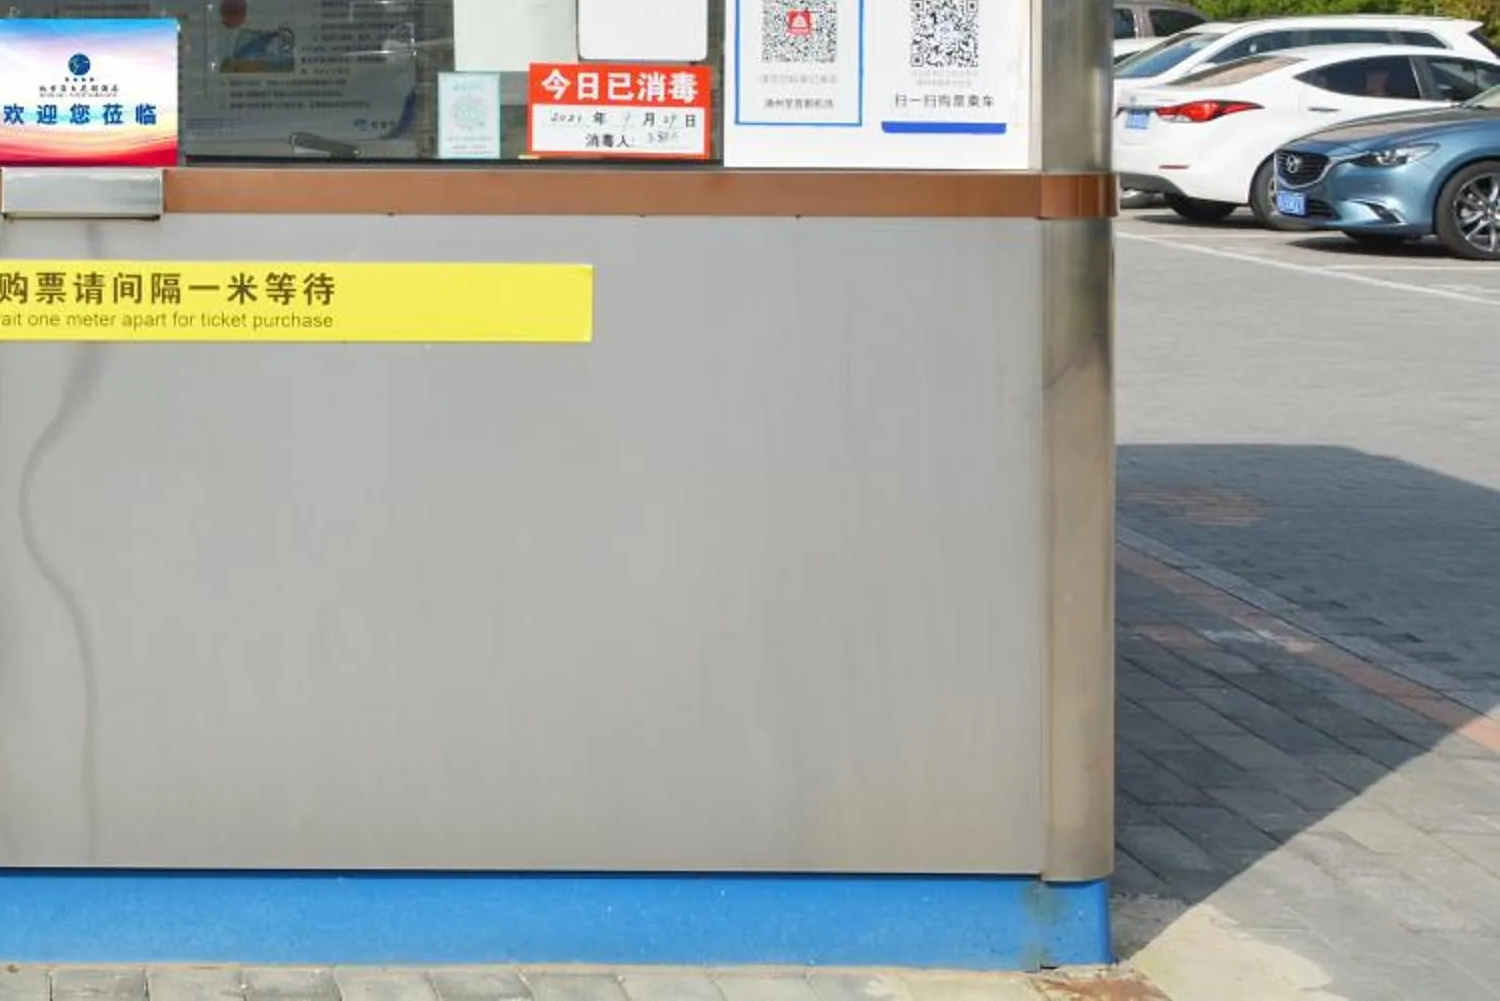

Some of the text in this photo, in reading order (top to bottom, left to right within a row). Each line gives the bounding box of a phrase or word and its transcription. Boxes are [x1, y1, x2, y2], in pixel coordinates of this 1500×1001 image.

[541, 69, 698, 103] 今日已消毒
[3, 103, 157, 125] 欢迎您莅临
[593, 112, 608, 126] 年
[643, 112, 655, 127] 月
[685, 114, 696, 128] 日
[28, 314, 60, 327] one
[66, 313, 116, 327] meter
[122, 313, 167, 331] apart
[173, 311, 196, 327] for
[201, 312, 246, 327] ticket
[253, 312, 333, 330] purchase
